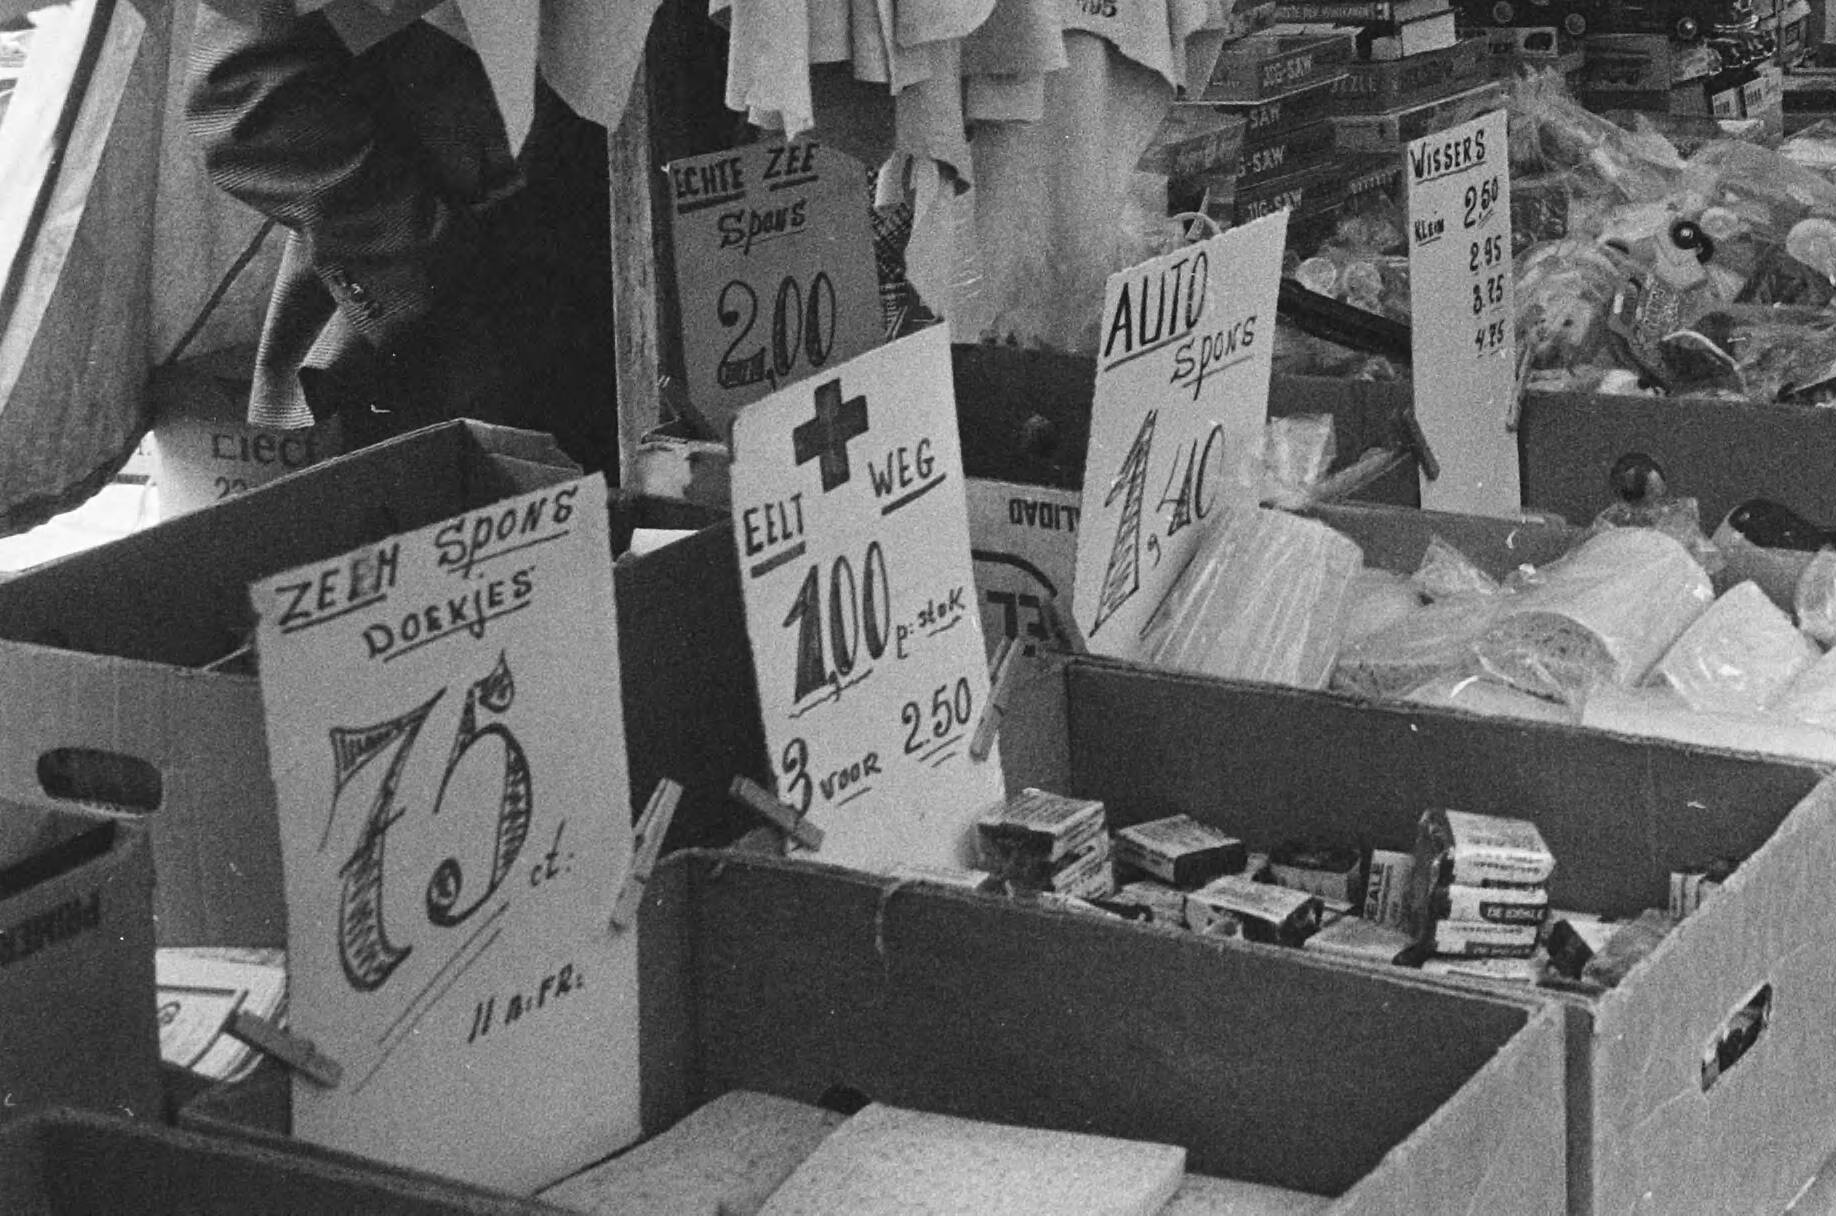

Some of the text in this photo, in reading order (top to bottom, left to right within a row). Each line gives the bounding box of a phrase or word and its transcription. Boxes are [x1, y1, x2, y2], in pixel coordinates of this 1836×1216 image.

[762, 143, 819, 181] ZEE
[1410, 129, 1485, 179] WISSERS
[1464, 175, 1498, 229] 2.50
[1105, 251, 1208, 358] AUTO
[867, 438, 935, 498] WEG
[743, 493, 804, 557] EELT
[783, 738, 814, 820] 3
[317, 647, 534, 993] 75
[467, 1002, 494, 1044] 11
